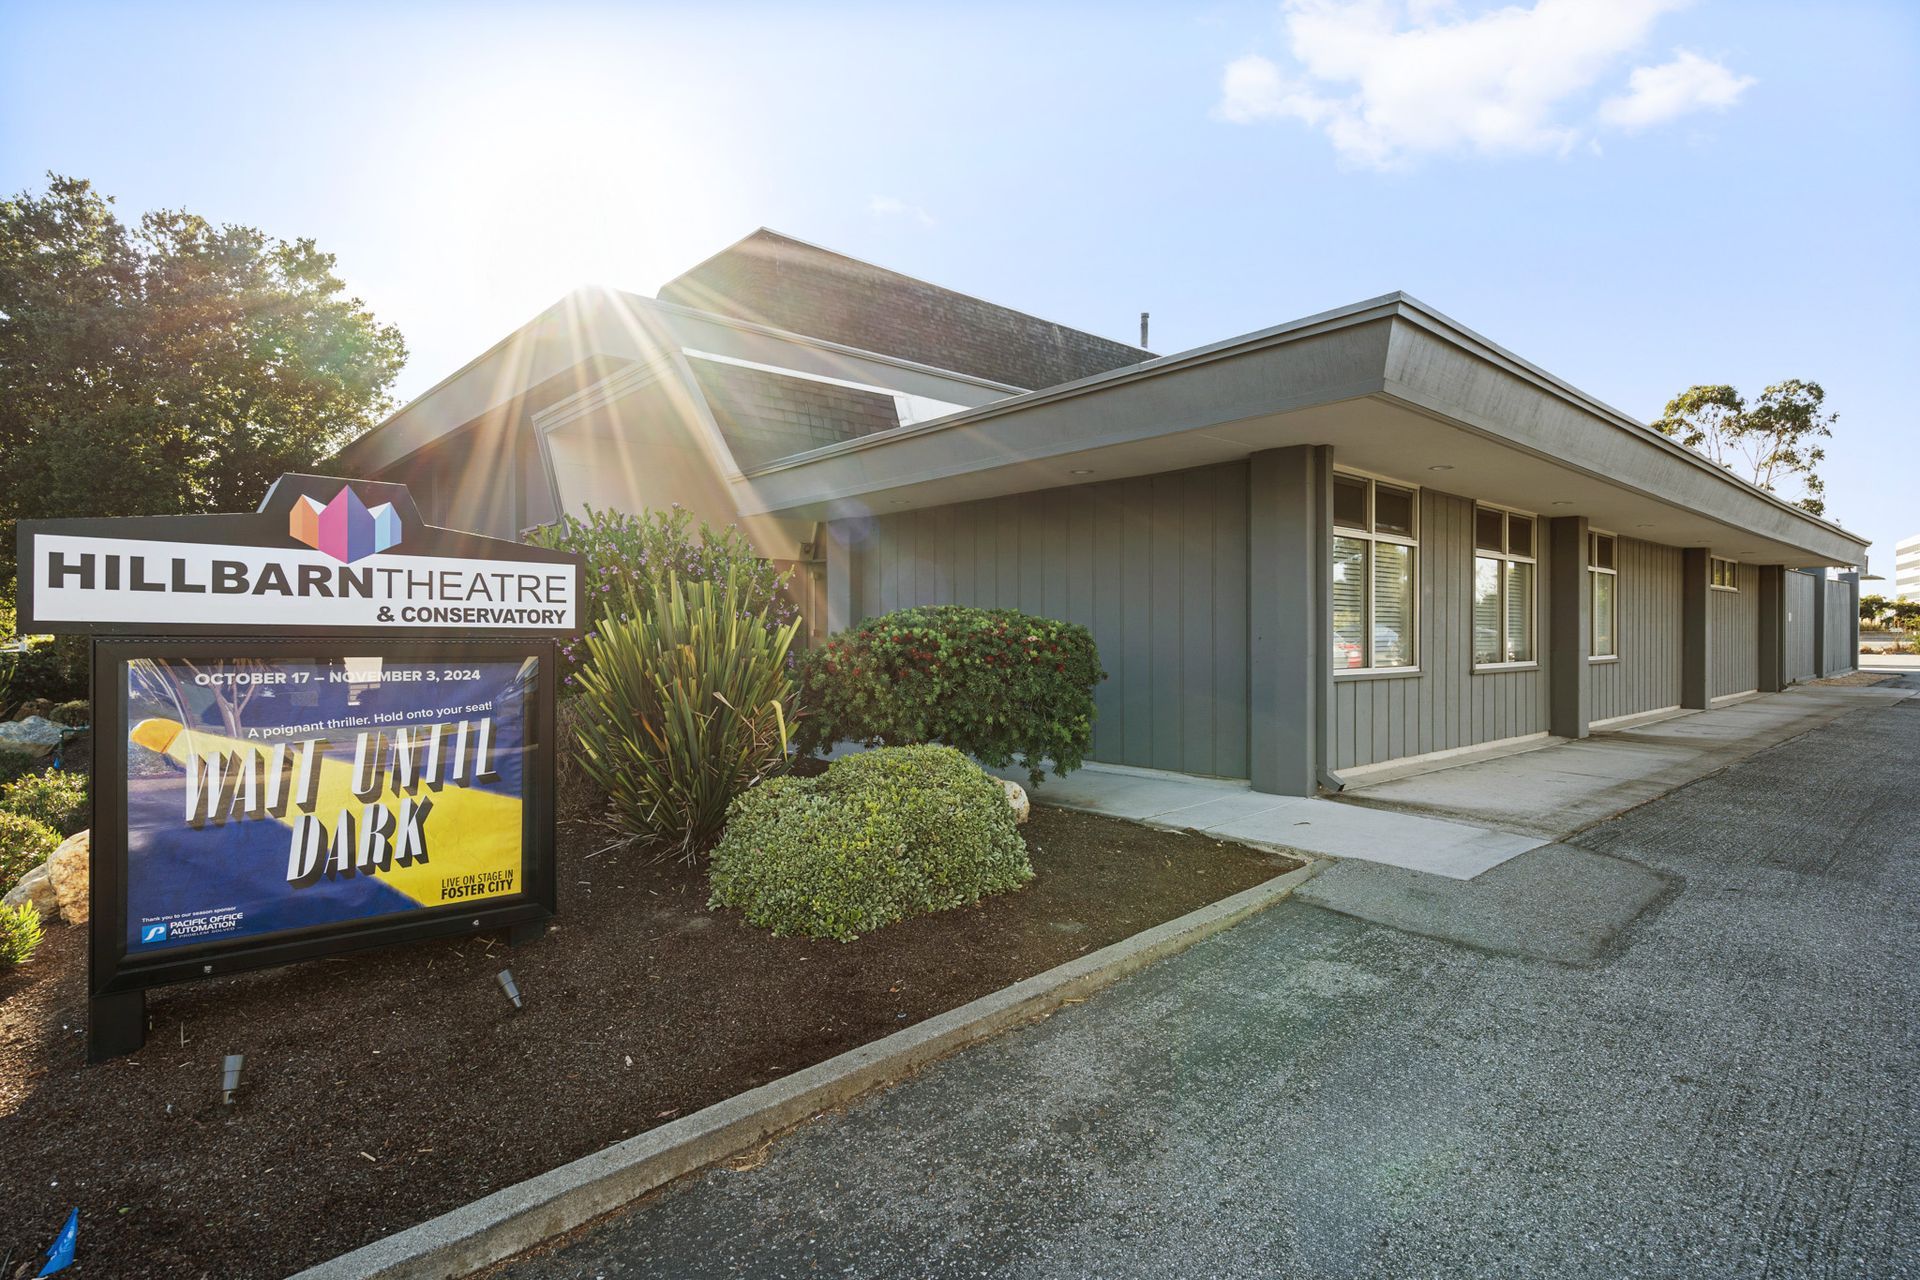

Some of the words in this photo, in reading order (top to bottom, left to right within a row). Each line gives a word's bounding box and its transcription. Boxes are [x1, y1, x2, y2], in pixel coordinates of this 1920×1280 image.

[376, 606, 395, 623] &
[401, 606, 567, 624] CONSERVATORY
[194, 672, 287, 685] OCTOBER
[291, 672, 310, 684] 17
[329, 670, 422, 683] NOVEMBER
[426, 670, 440, 683] 3,
[443, 669, 481, 681] 2024
[248, 727, 259, 738] A
[263, 720, 324, 739] poignant
[327, 716, 371, 730] thriller.
[374, 711, 403, 723] Hold
[406, 708, 434, 720] onto
[436, 704, 463, 717] your
[465, 701, 493, 713] seat!
[185, 738, 327, 826] WAIT
[351, 717, 500, 800] UNTIL
[286, 795, 432, 886] DARK
[441, 876, 460, 889] LIVE
[462, 874, 475, 885] ON
[477, 870, 503, 883] STAGE
[504, 869, 514, 879] IN
[441, 883, 485, 900] FOSTER
[488, 878, 514, 893] CITY
[170, 917, 207, 929] PACIFIC
[209, 912, 244, 923] OFFICE
[170, 920, 236, 936] AUTOMATION
